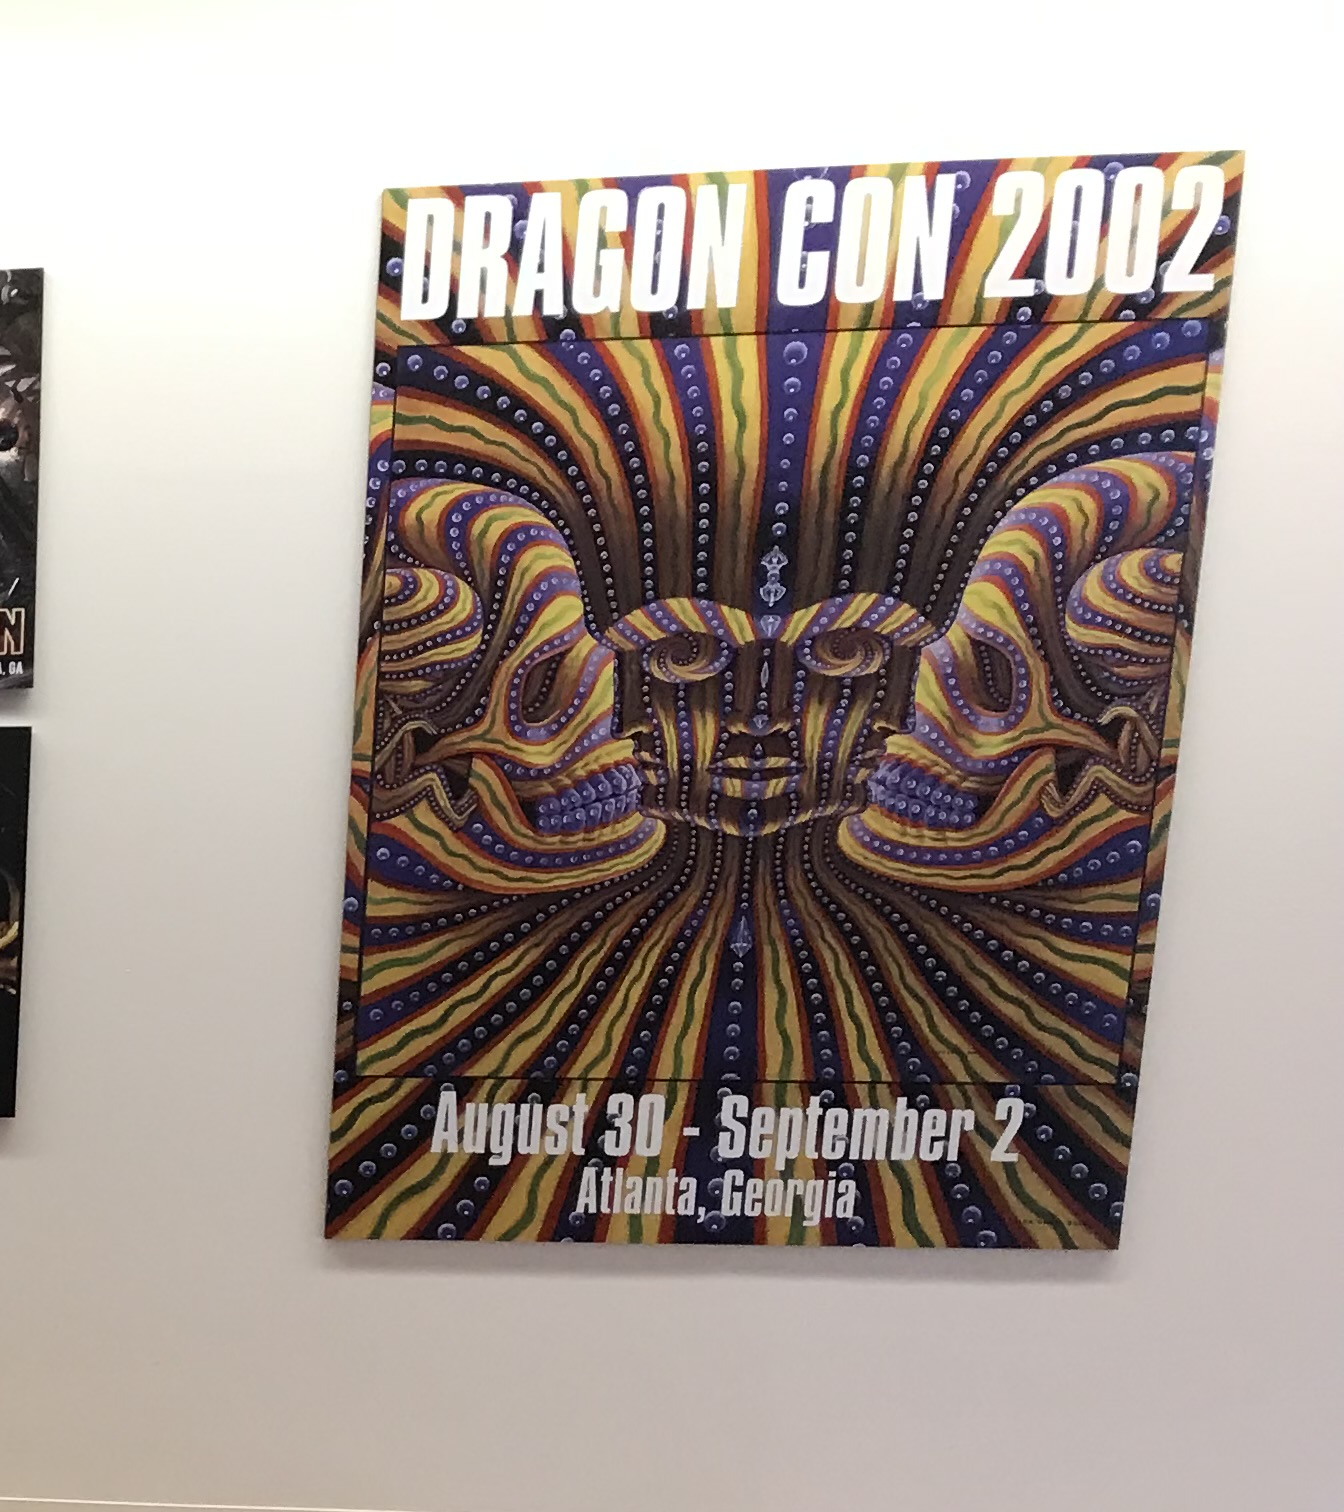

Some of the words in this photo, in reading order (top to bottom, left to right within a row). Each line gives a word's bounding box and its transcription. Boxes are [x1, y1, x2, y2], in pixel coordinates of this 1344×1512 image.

[402, 182, 747, 320] DRAGON
[777, 172, 959, 304] CON
[983, 165, 1223, 298] 2002
[431, 1090, 591, 1167] August
[603, 1093, 666, 1157] 30
[718, 1097, 976, 1164] September
[990, 1097, 1025, 1162] 2
[576, 1167, 706, 1225] Atlanta,
[720, 1169, 857, 1228] Georgia
